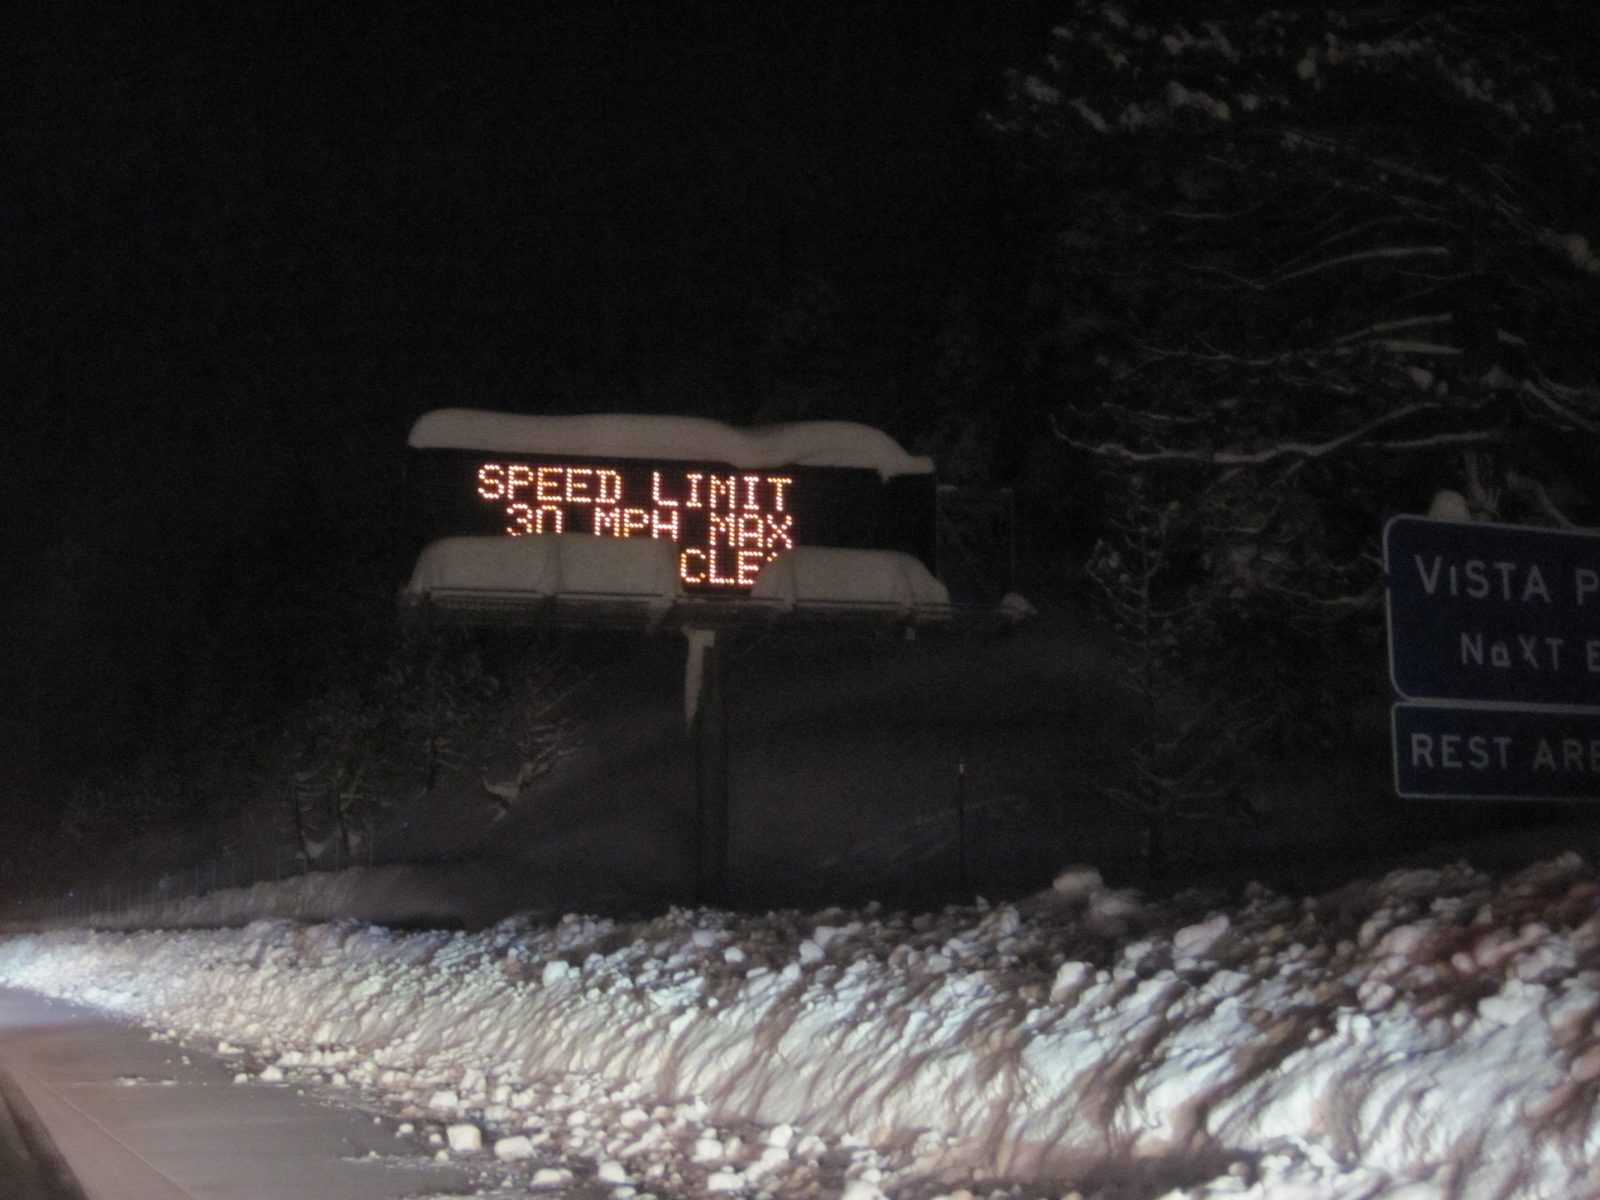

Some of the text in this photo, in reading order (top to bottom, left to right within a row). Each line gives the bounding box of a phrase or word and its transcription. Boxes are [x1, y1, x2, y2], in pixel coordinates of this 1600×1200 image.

[478, 464, 792, 512] SPEED LIMIT
[595, 507, 679, 540] MPH
[710, 512, 792, 550] MAX
[680, 548, 778, 584] CLE
[1411, 733, 1513, 769] REST
